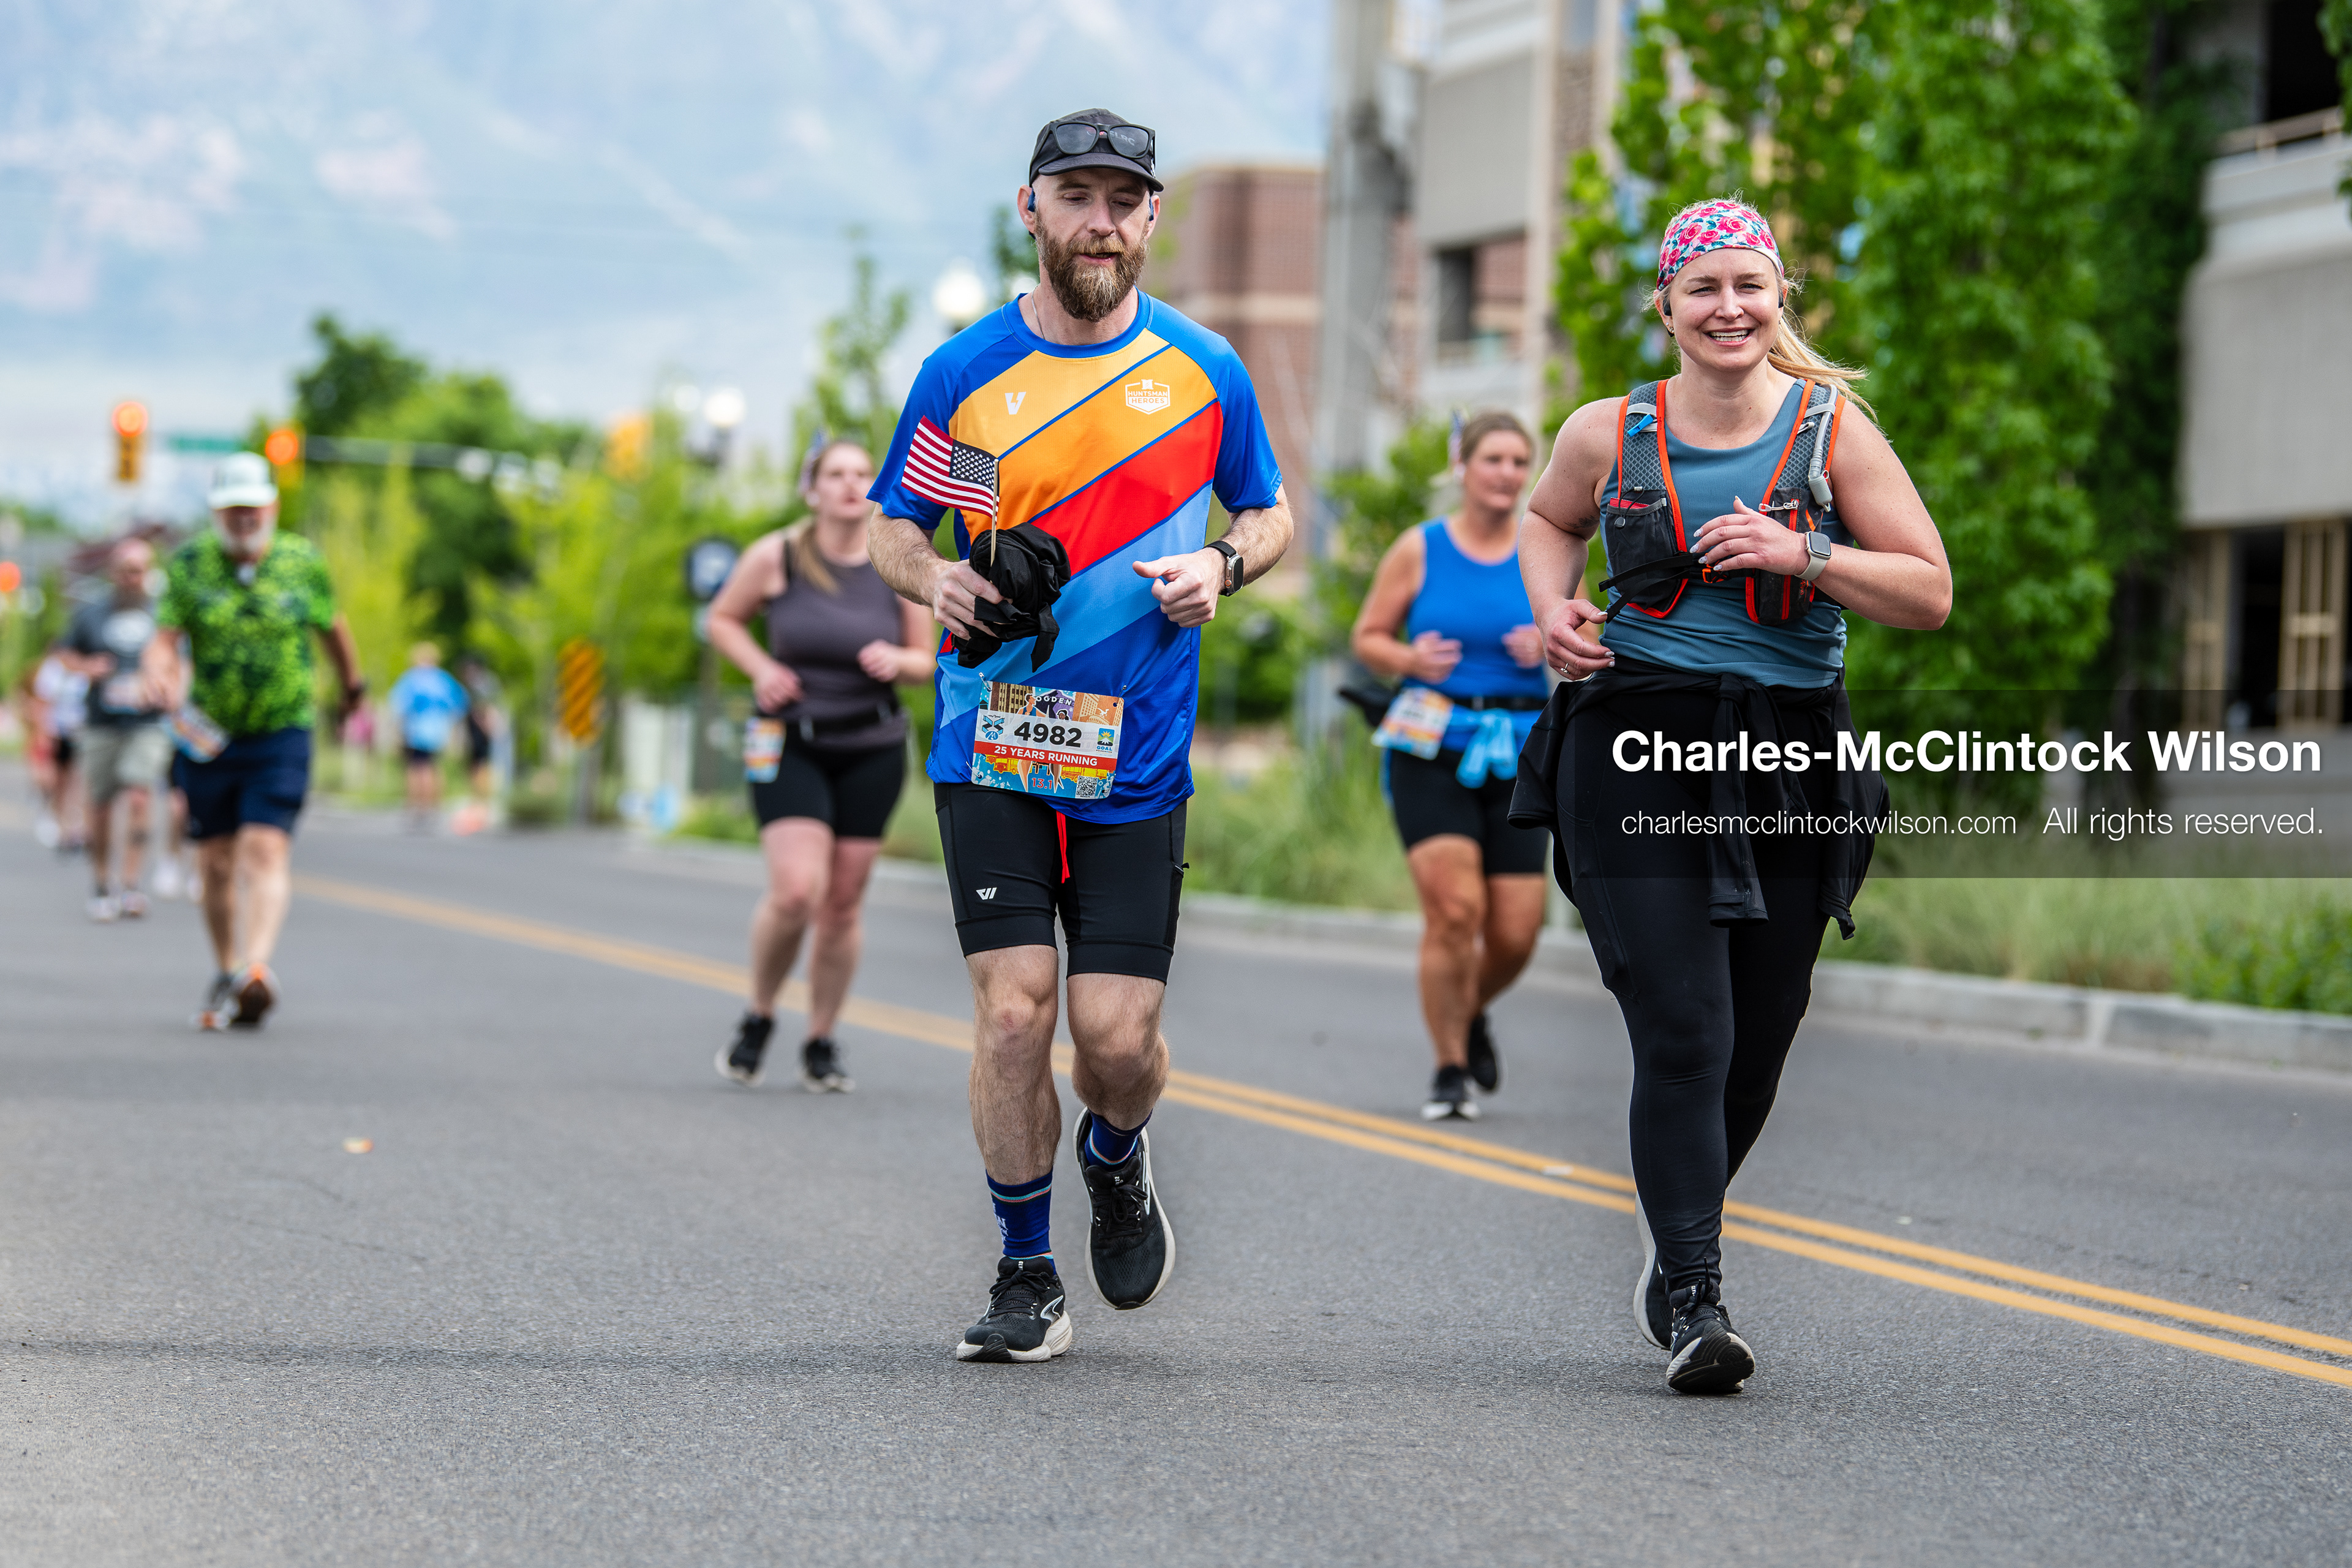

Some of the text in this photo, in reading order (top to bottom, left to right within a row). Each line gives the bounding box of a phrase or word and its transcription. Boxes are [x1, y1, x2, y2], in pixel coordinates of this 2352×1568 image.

[1109, 130, 1136, 146] SLRC
[1036, 696, 1072, 706] OGDEN
[1014, 721, 1082, 748] 4982
[994, 745, 1098, 766] 25 YEARS RUNNING
[1031, 778, 1052, 790] 13.1
